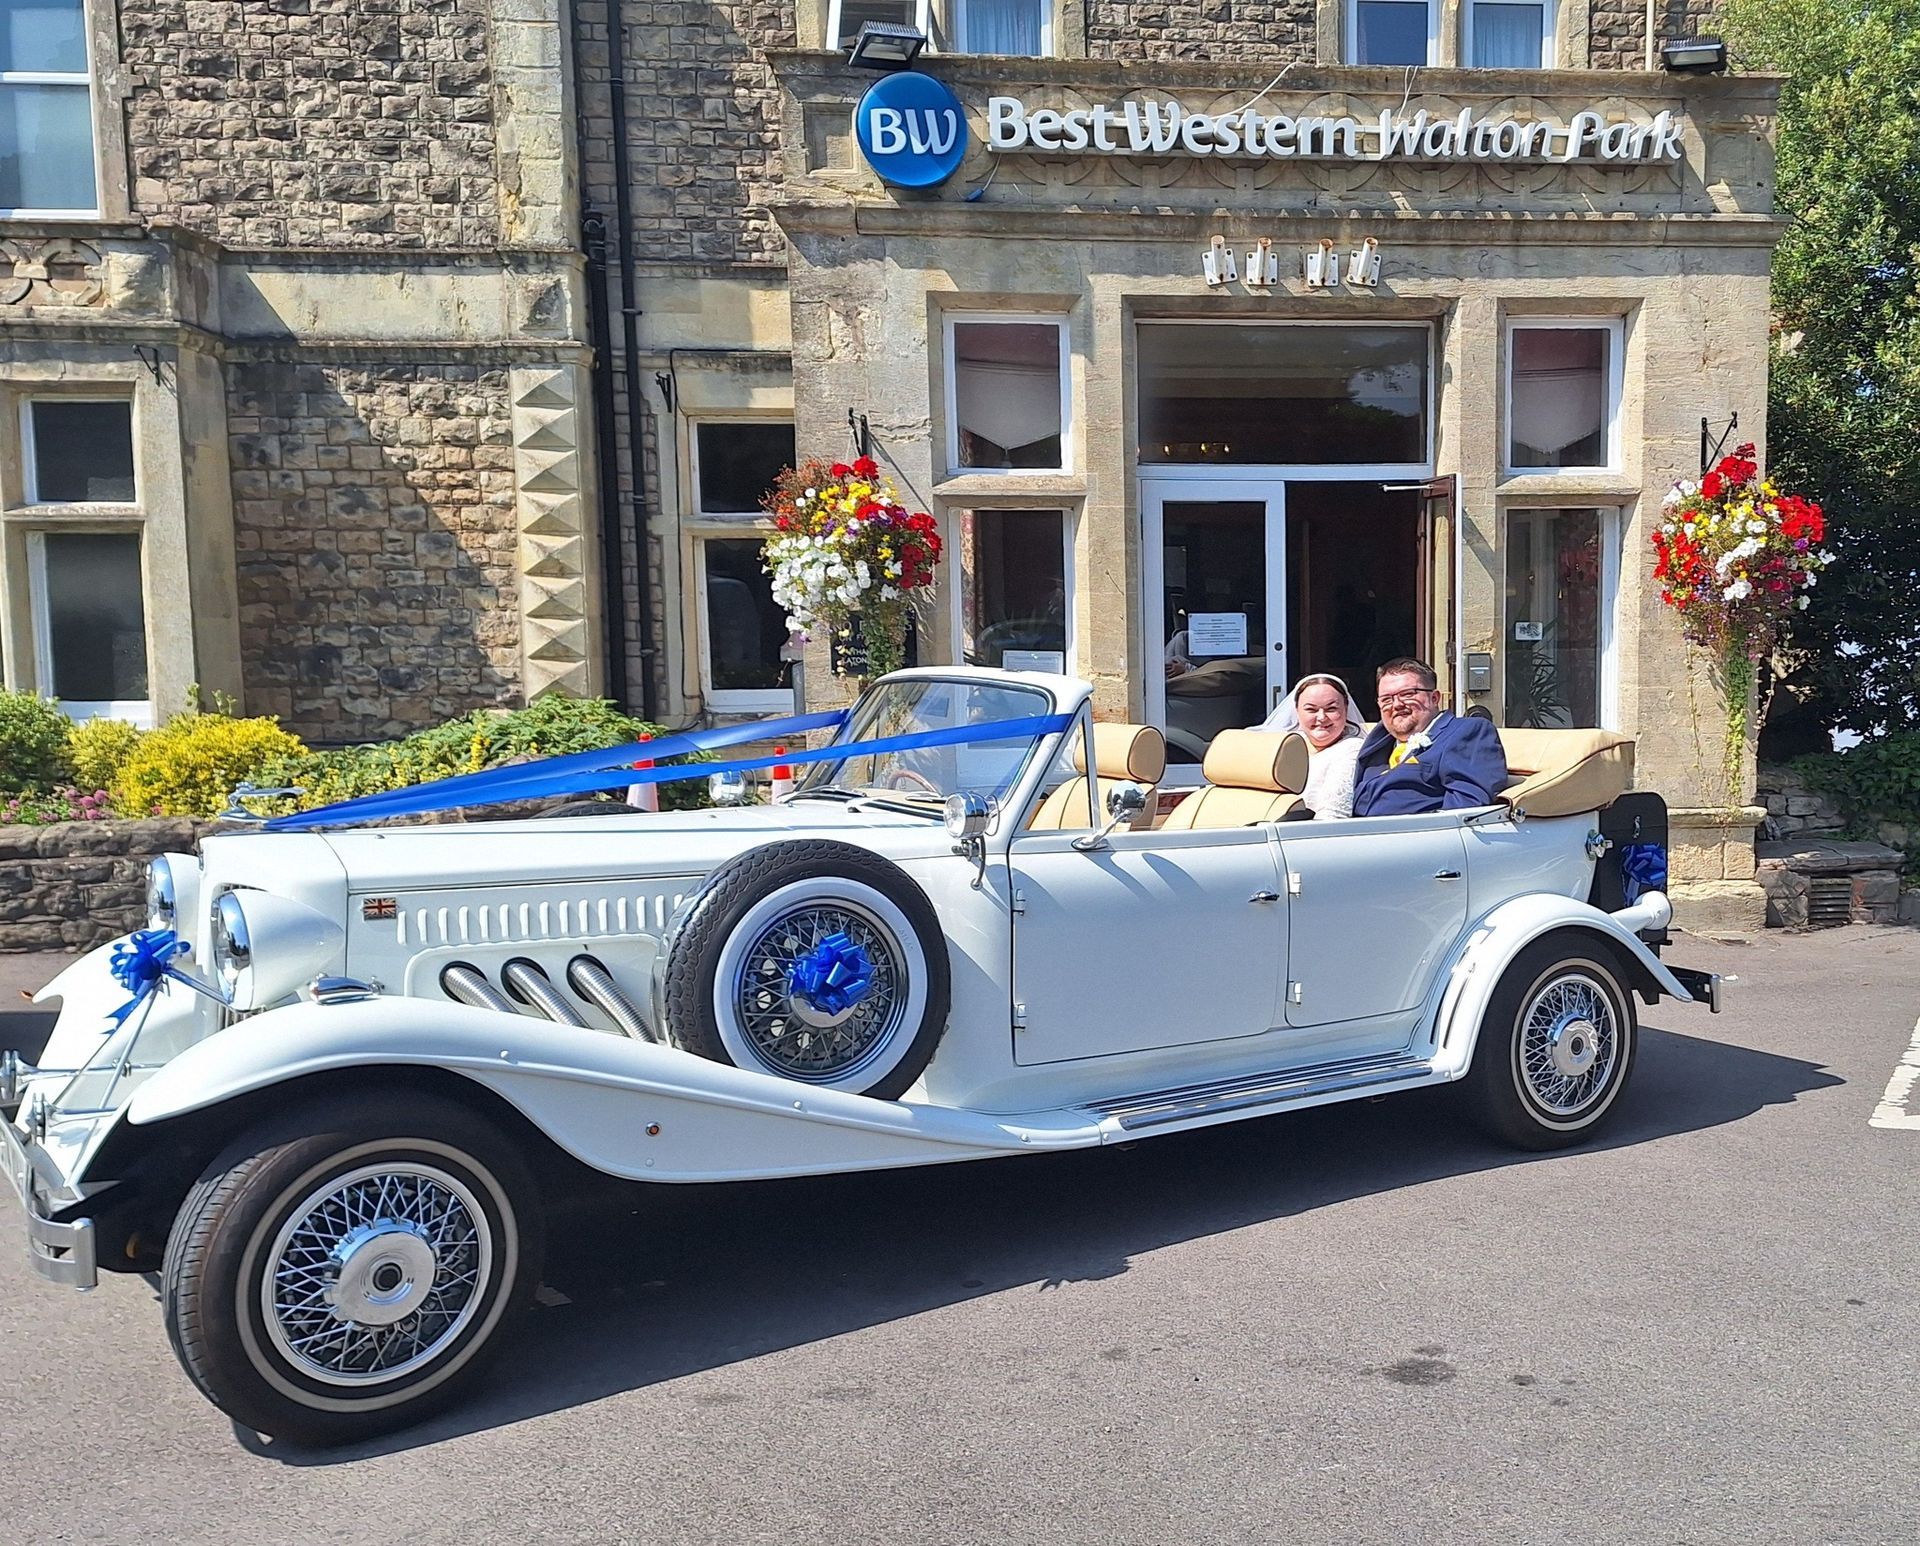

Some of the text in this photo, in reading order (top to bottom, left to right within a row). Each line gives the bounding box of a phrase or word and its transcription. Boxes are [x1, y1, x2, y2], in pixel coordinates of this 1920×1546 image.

[870, 107, 957, 155] BW
[987, 97, 1687, 161] Best Western Walton Park
